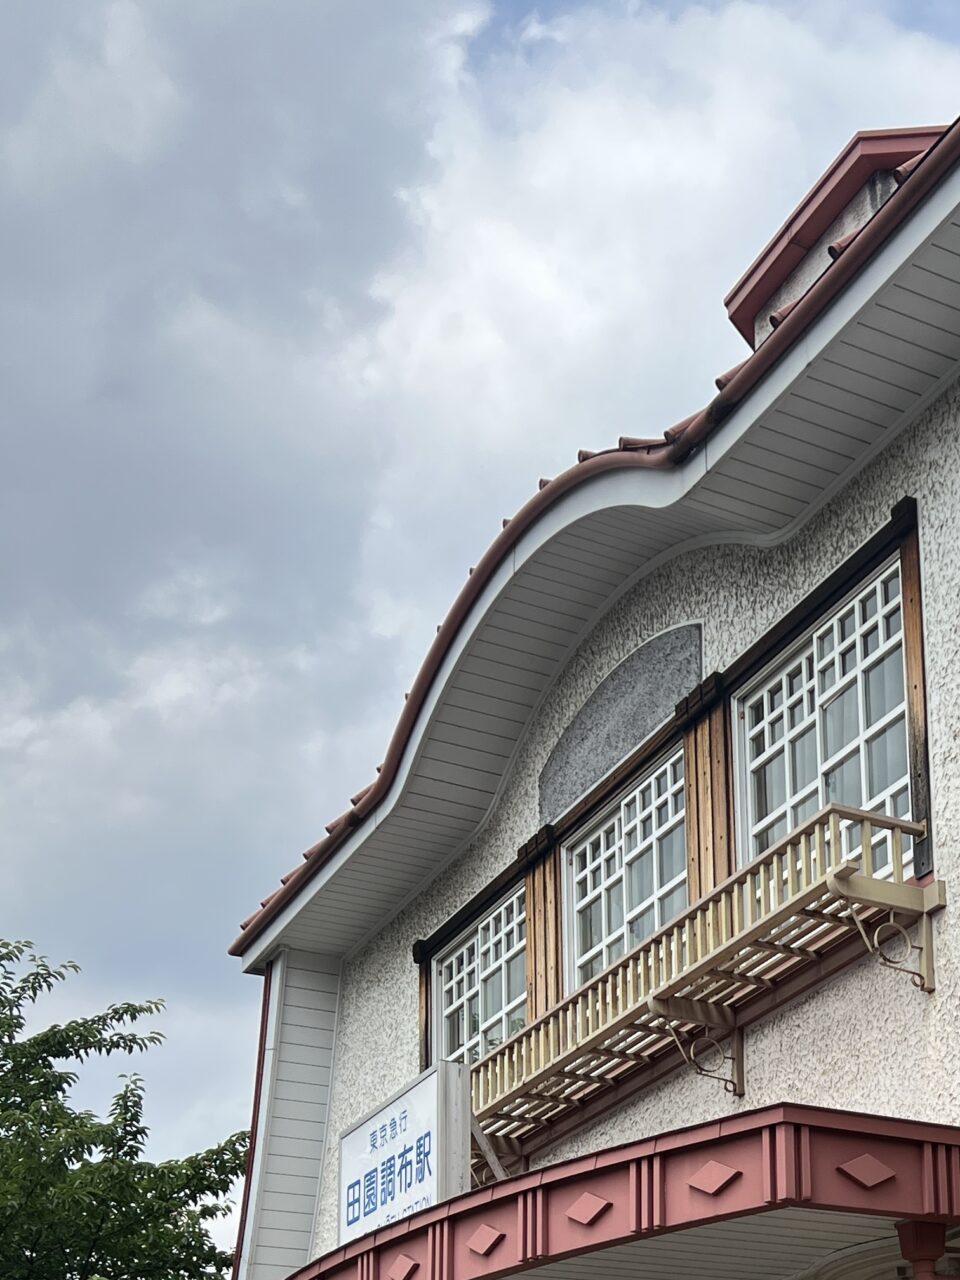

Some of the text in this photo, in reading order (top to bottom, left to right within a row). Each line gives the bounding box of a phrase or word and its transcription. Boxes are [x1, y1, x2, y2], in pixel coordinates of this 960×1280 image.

[369, 1109, 408, 1154] 東京急行
[346, 1131, 432, 1227] 田園調布駅
